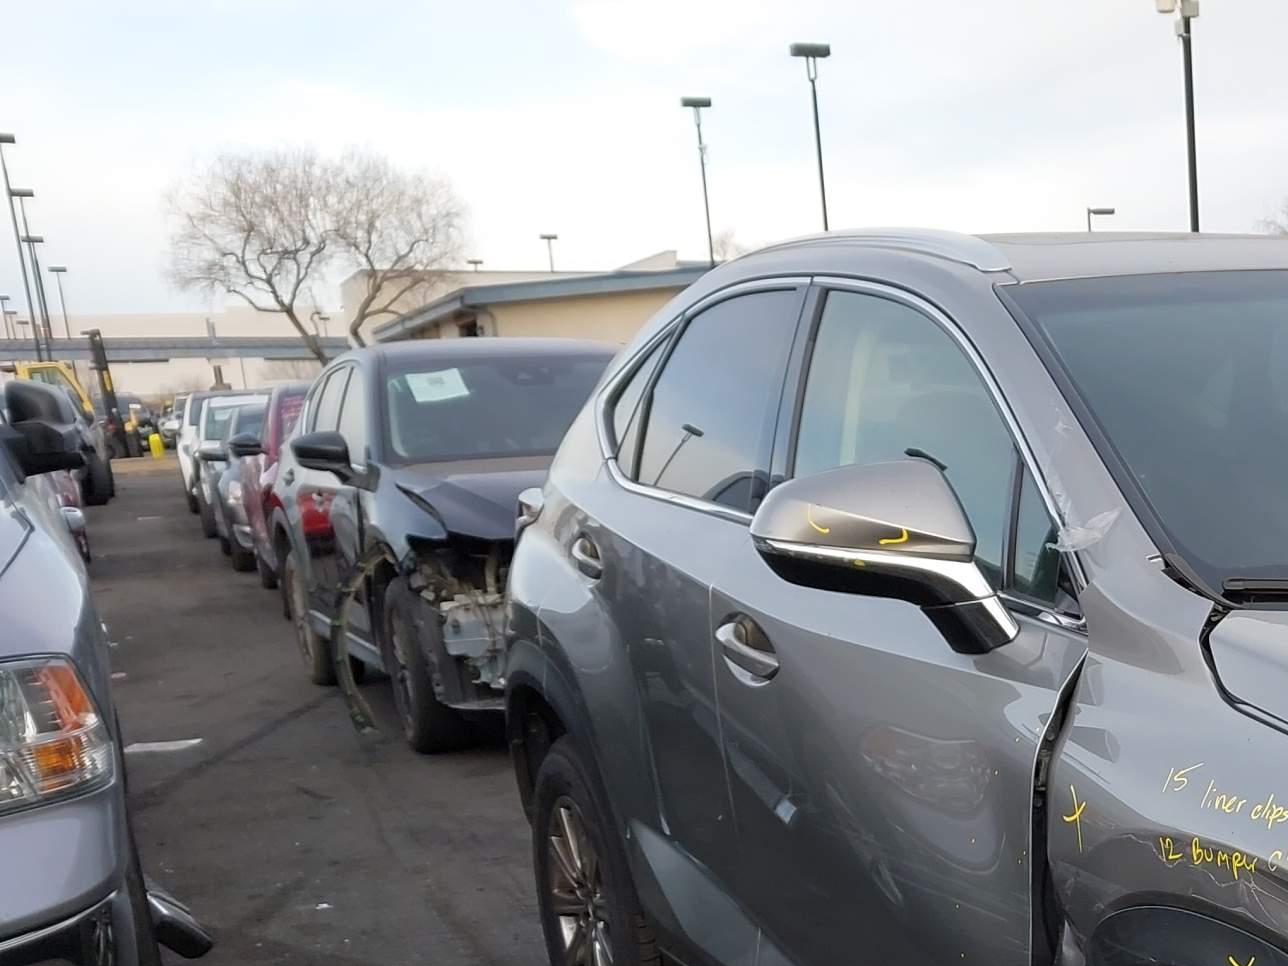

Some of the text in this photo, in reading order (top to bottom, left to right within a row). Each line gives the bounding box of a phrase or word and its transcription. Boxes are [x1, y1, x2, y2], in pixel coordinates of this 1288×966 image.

[1162, 762, 1205, 793] 15
[1200, 779, 1247, 809] liner
[1160, 836, 1184, 862] 12
